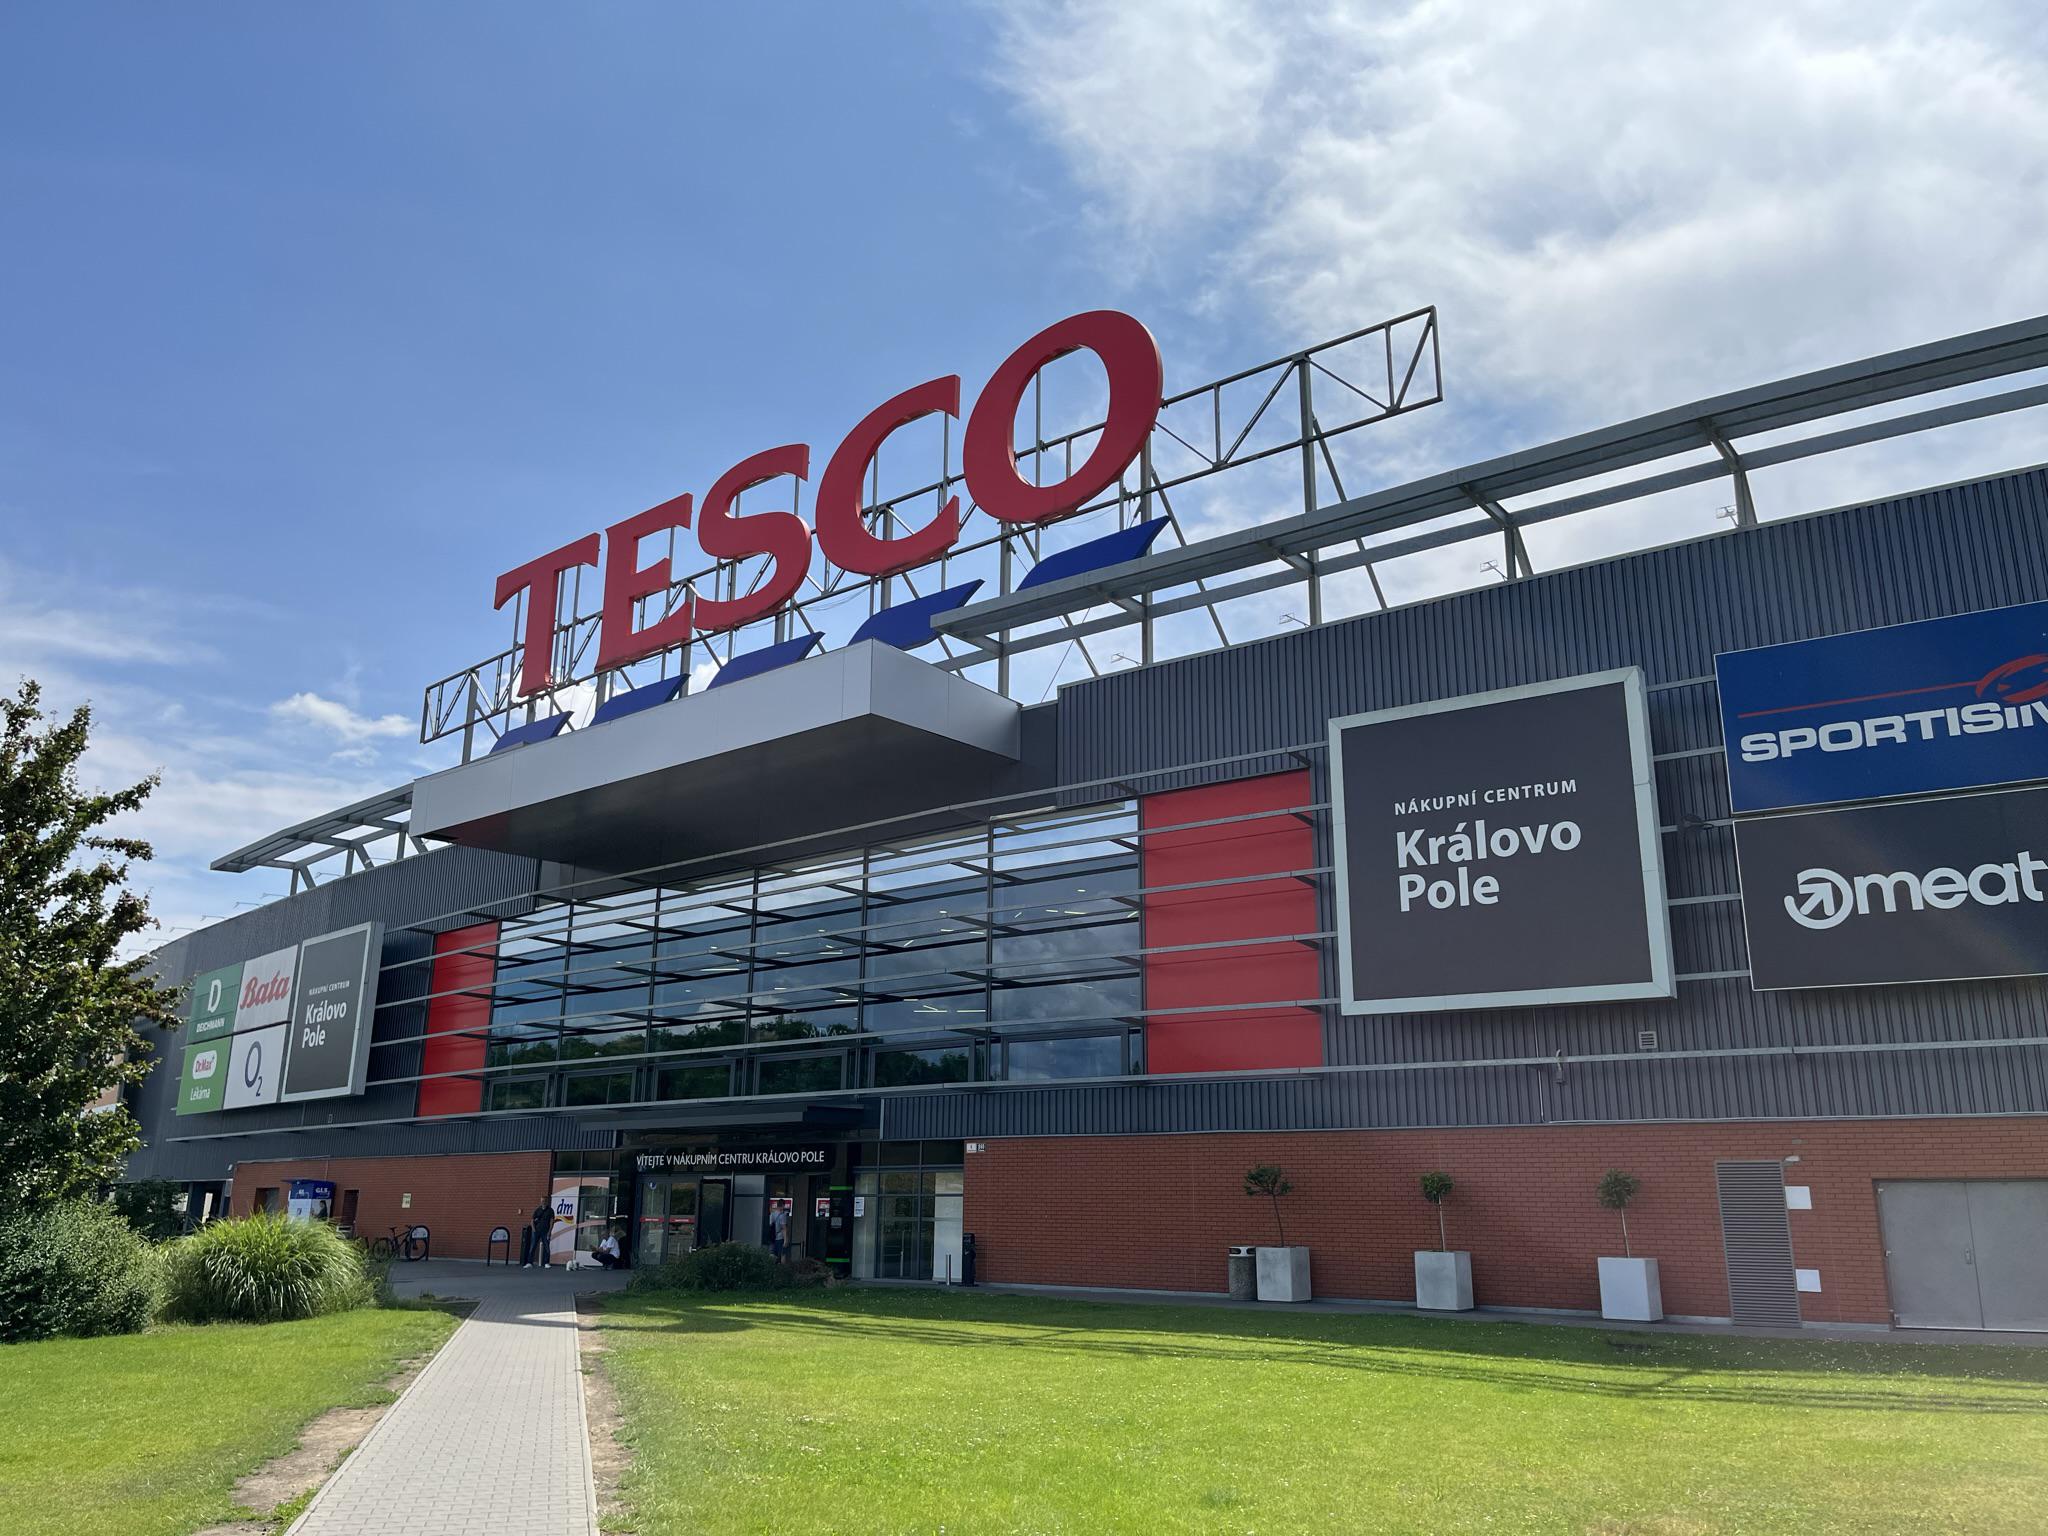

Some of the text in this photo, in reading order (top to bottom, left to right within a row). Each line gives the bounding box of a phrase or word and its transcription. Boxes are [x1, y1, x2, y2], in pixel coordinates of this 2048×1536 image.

[494, 309, 1164, 698] TESCO
[1394, 779, 1577, 816] NÁKUPNÍ CENTRUM
[1396, 819, 1582, 868] Královo
[1399, 866, 1500, 912] Pole
[305, 1000, 347, 1025] Královo
[302, 1024, 326, 1048] Pole
[636, 1149, 825, 1168] VÍTEJTE V NÁKUPNÍM CENTRU KRÁLOVO POLE
[557, 1199, 574, 1215] dm
